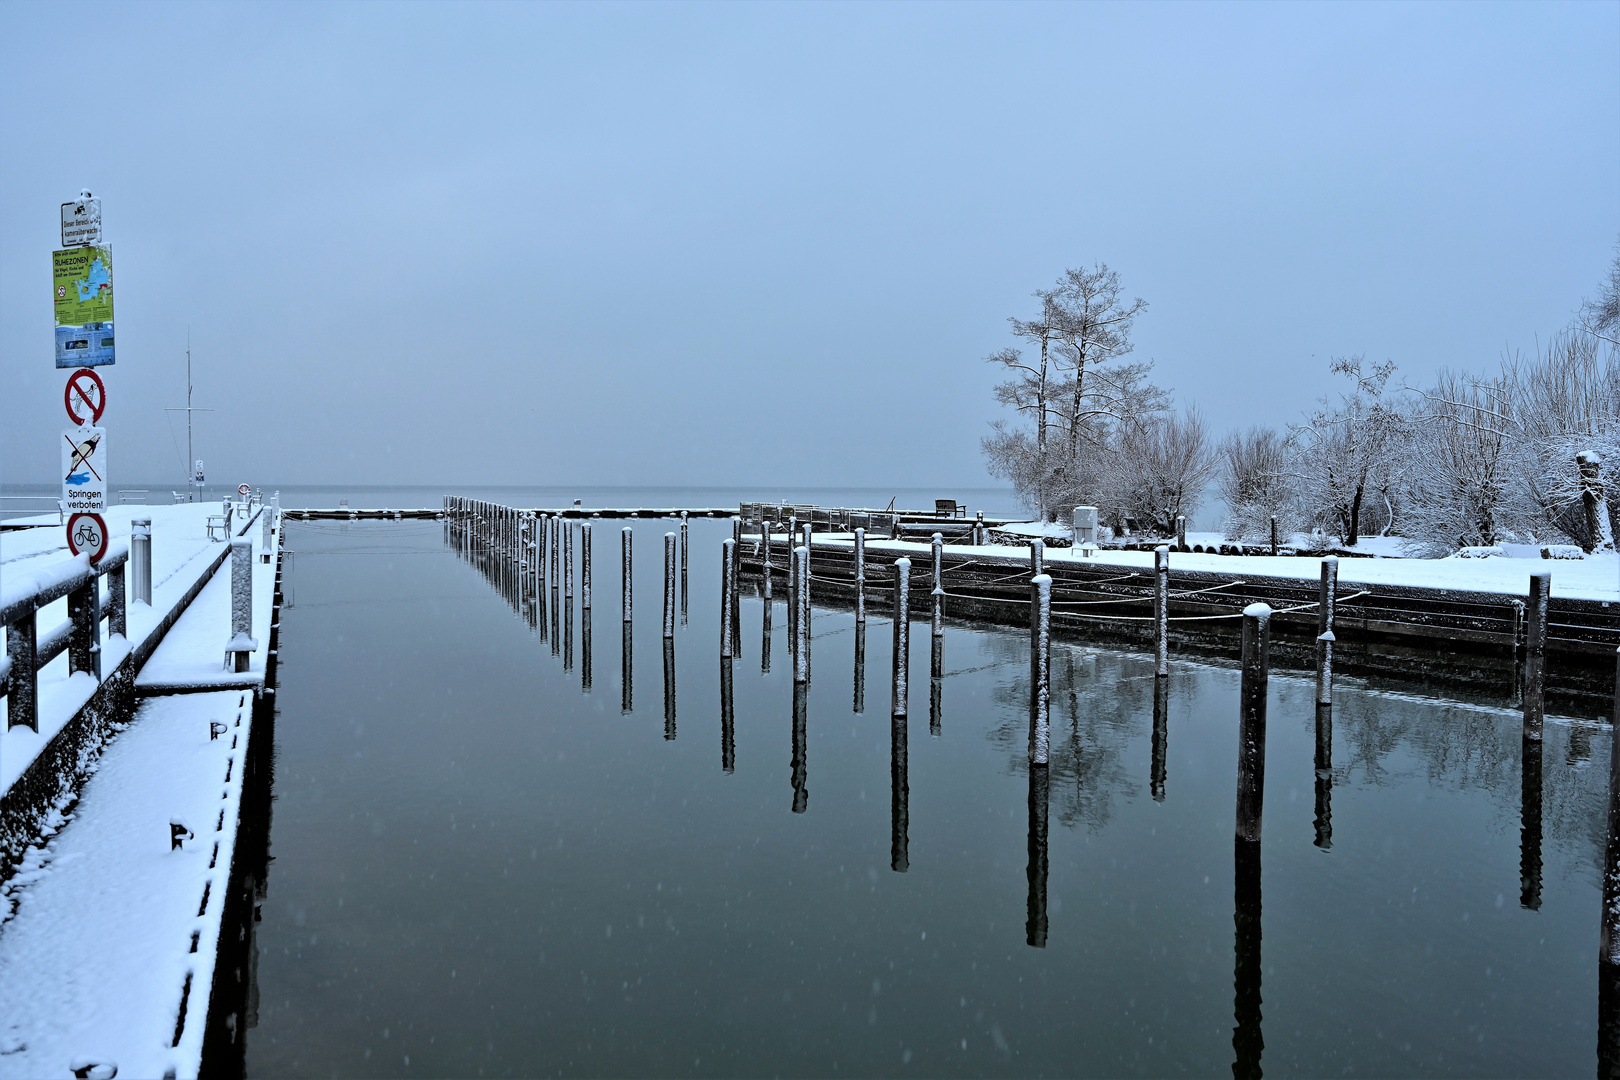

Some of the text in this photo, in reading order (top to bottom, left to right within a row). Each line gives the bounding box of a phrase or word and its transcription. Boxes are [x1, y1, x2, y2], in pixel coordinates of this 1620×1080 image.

[55, 256, 88, 266] RUHEZONEN
[68, 490, 102, 500] Springen
[67, 501, 103, 509] verboten!
